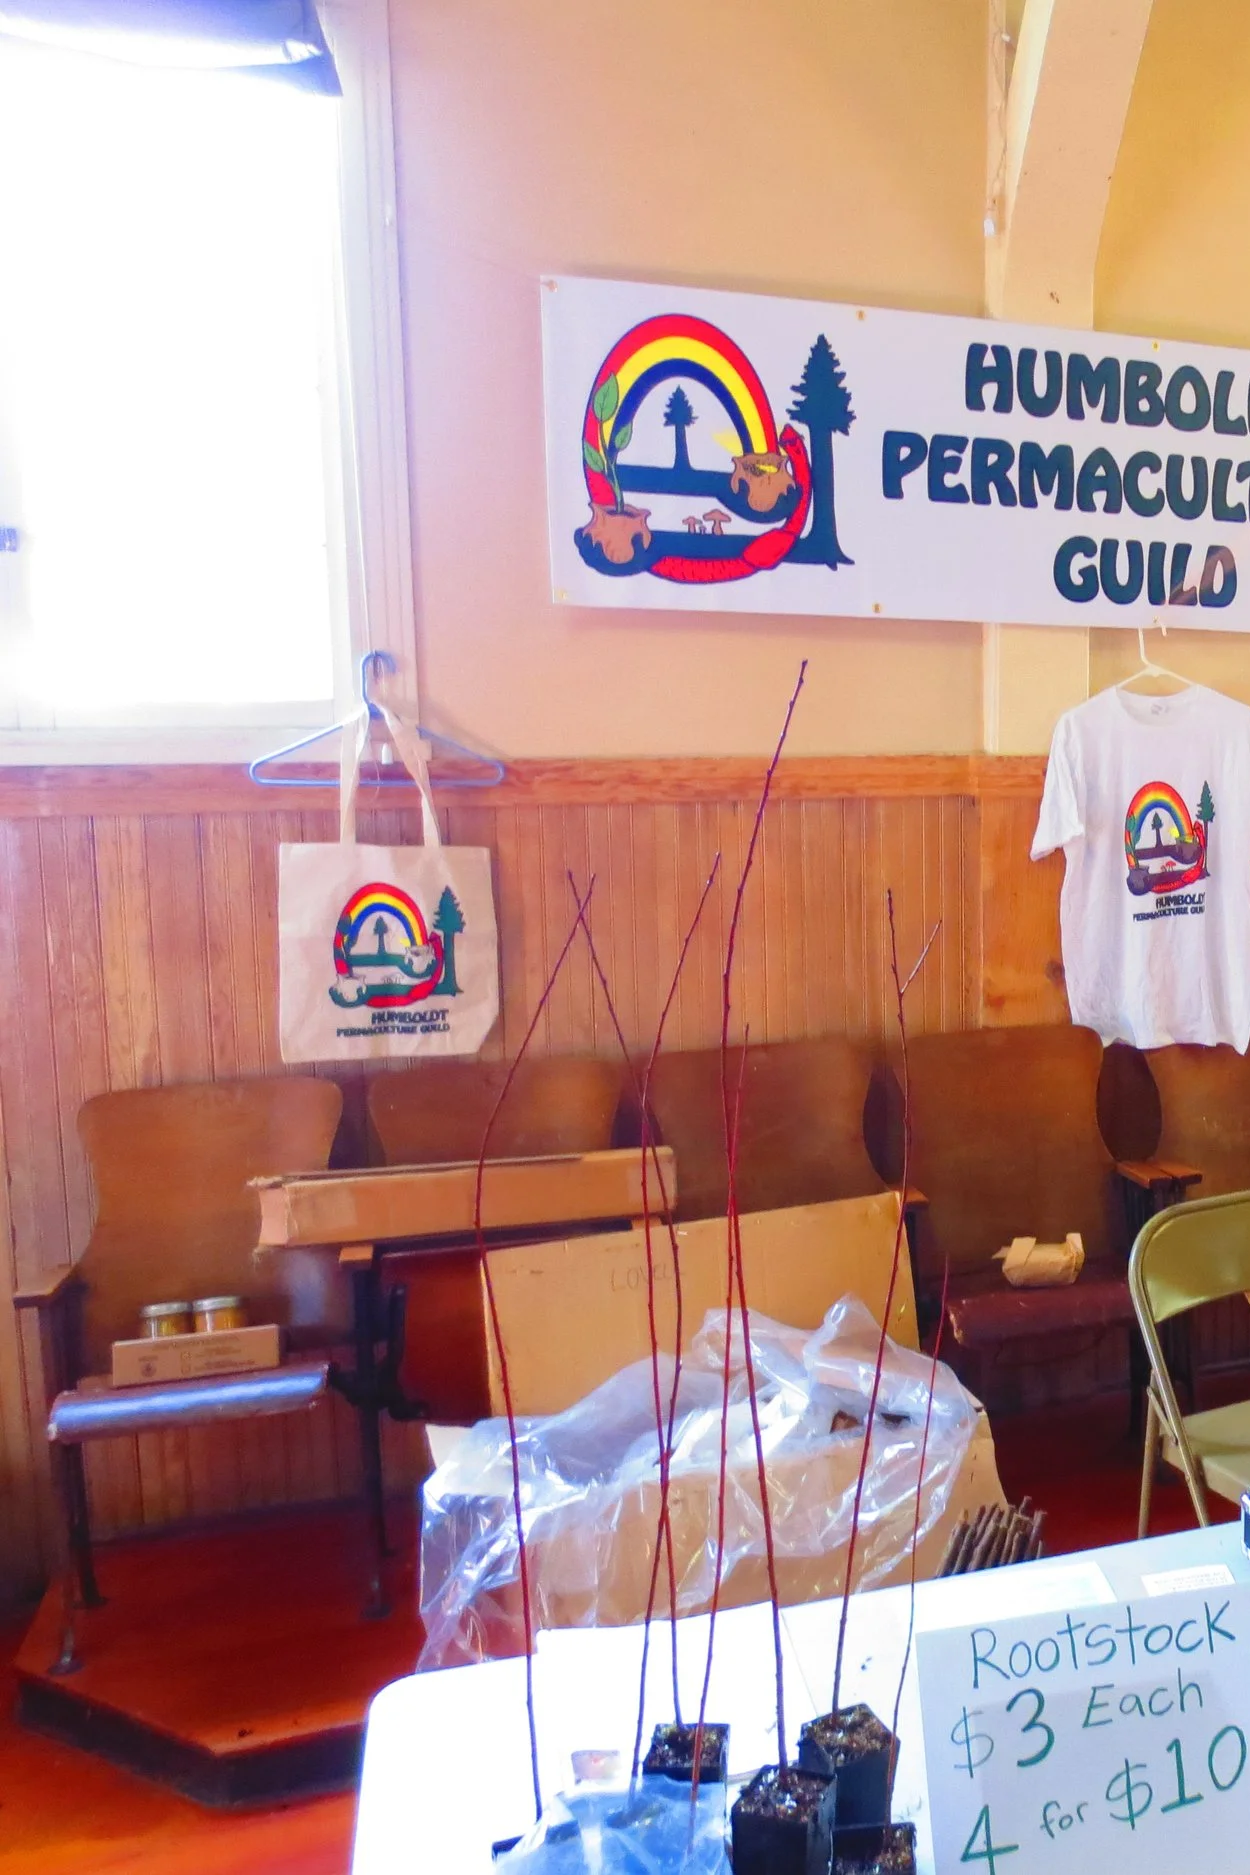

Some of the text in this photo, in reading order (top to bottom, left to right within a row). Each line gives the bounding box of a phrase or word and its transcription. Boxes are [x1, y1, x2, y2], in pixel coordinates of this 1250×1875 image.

[1053, 535, 1238, 608] GUILD
[371, 1009, 449, 1025] HUMBOLDT
[970, 1600, 1236, 1689] Rootstock
[1082, 1667, 1203, 1729] Each
[960, 1724, 1248, 1875] 4 for $10
